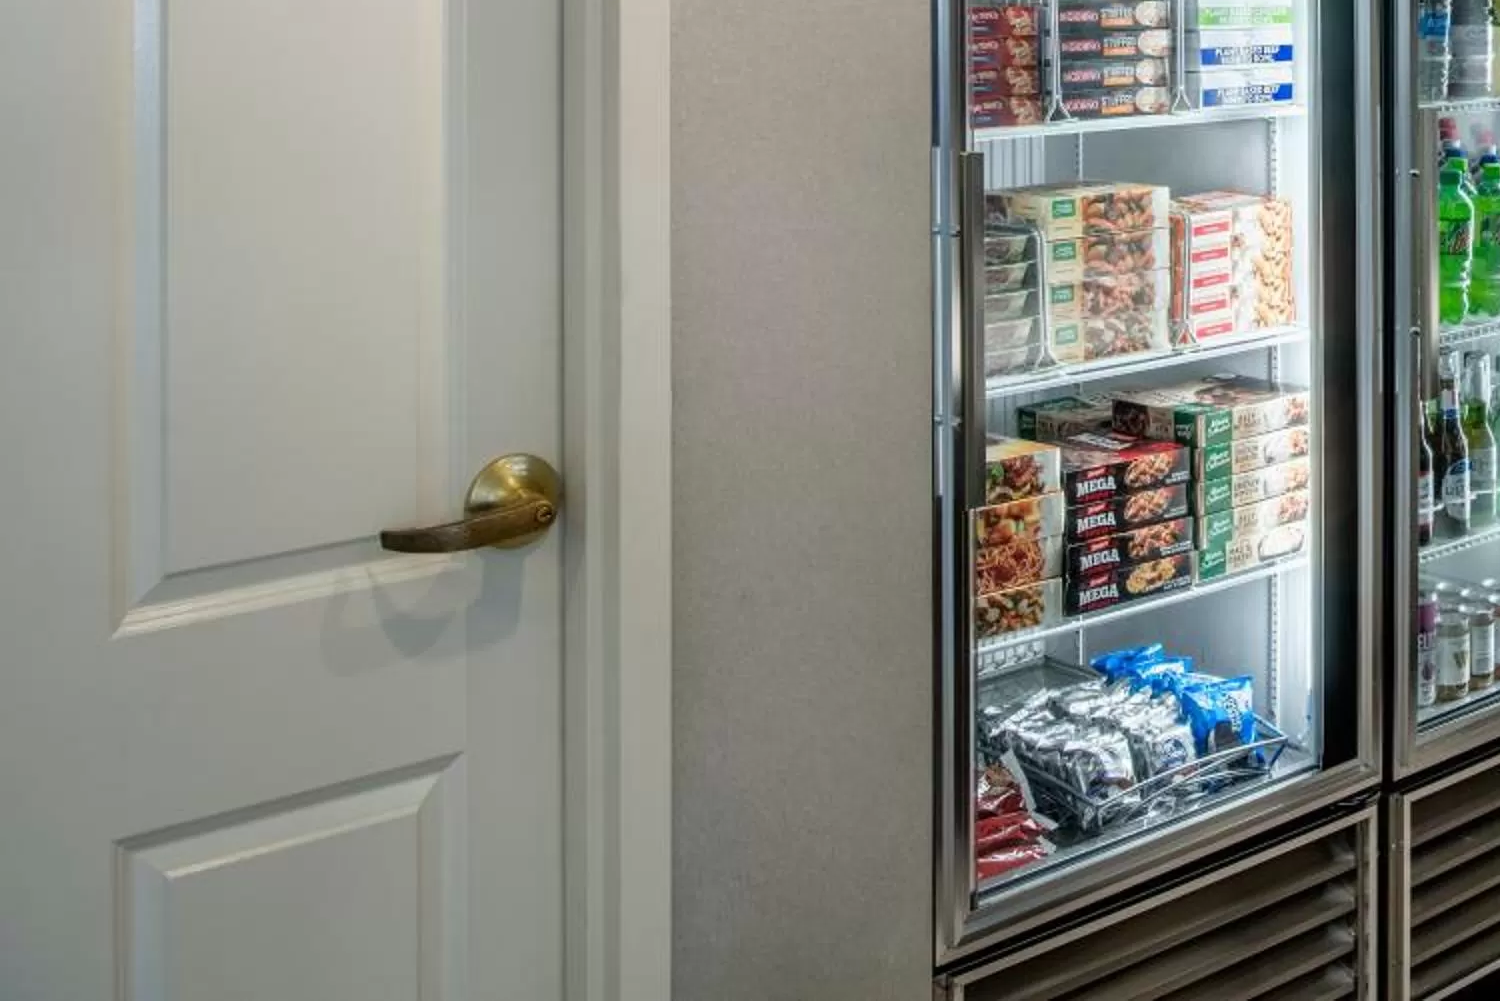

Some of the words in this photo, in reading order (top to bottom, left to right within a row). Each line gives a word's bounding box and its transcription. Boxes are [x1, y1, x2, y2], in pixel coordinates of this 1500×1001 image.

[1076, 475, 1117, 498] MEGA
[1077, 511, 1117, 534] MEGA
[1079, 548, 1121, 572] MEGA
[1079, 583, 1120, 606] MEGA
